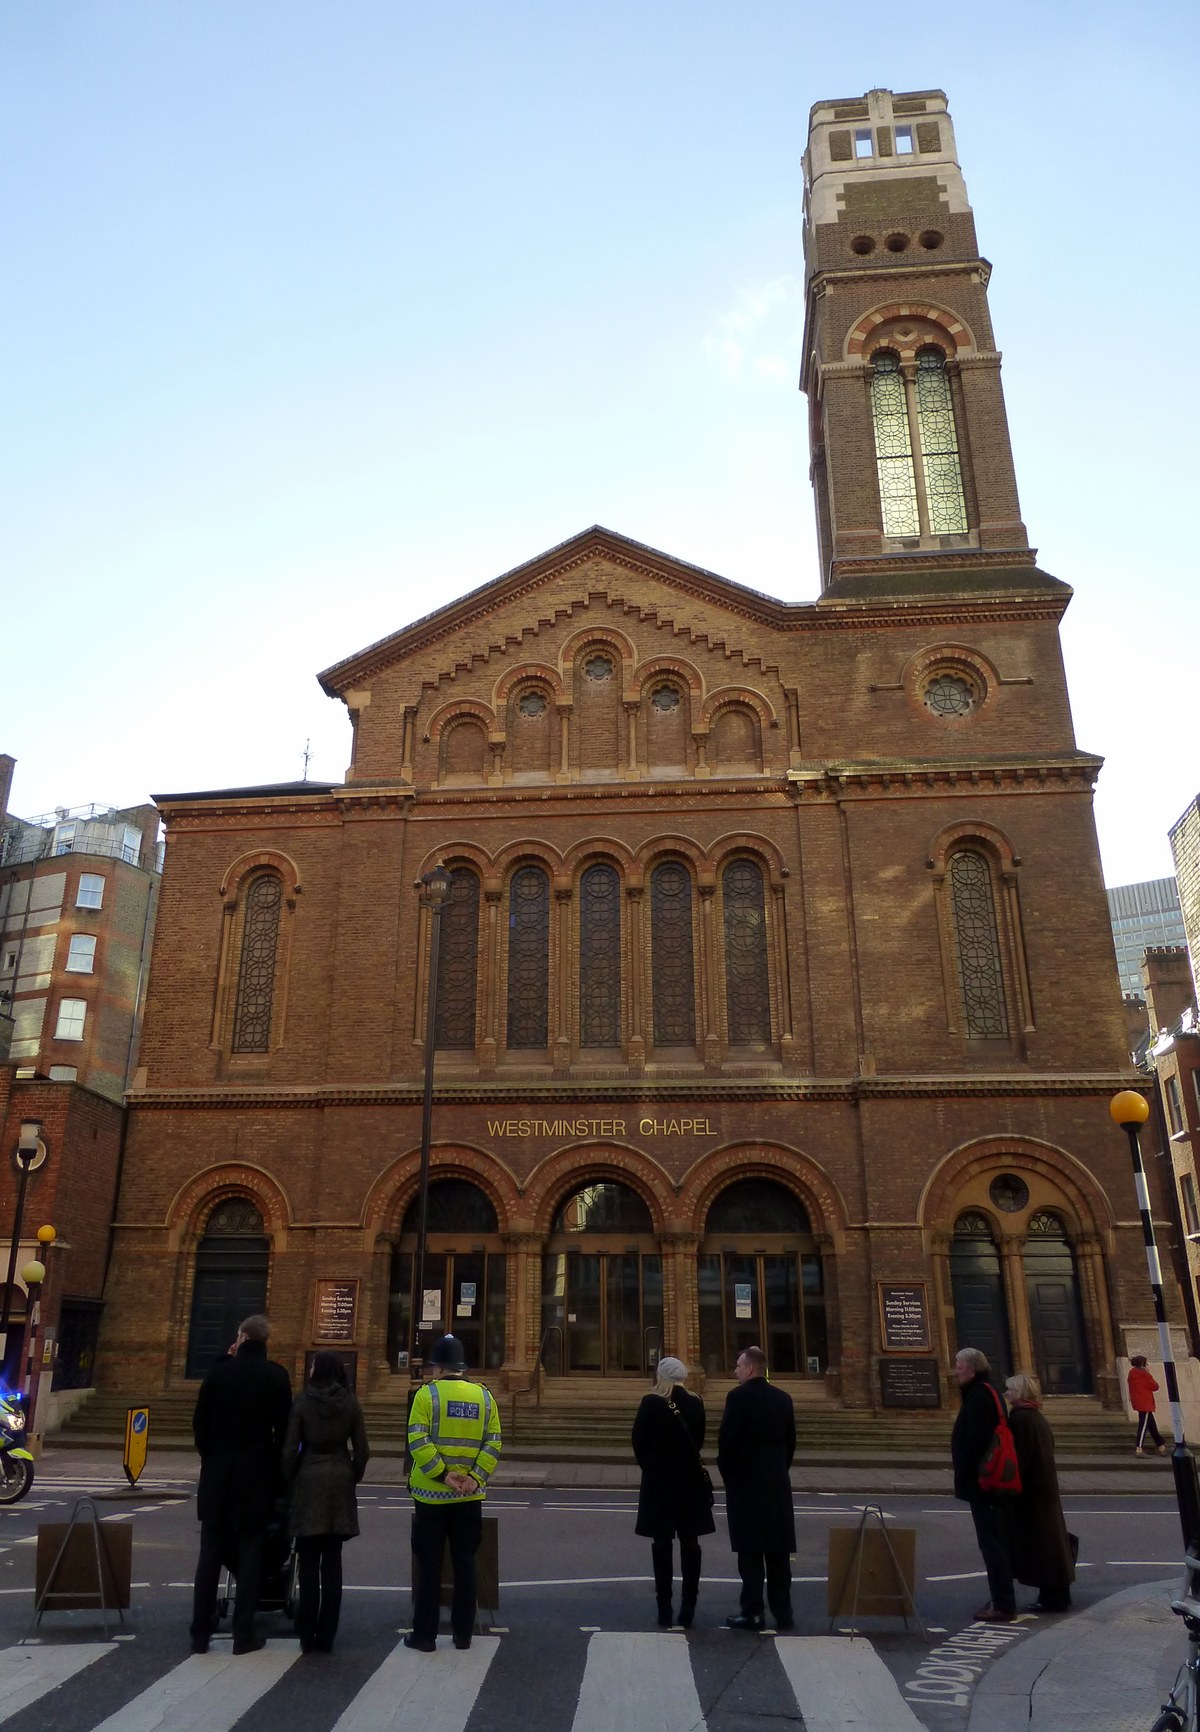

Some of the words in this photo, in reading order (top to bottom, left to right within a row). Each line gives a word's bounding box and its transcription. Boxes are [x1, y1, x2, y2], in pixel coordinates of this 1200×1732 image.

[487, 1119, 626, 1137] WESTMINSTER
[638, 1118, 717, 1136] CHAPEL
[449, 1406, 478, 1417] POLICE
[929, 1621, 1029, 1658] RIGHT
[904, 1656, 983, 1707] LOOK
